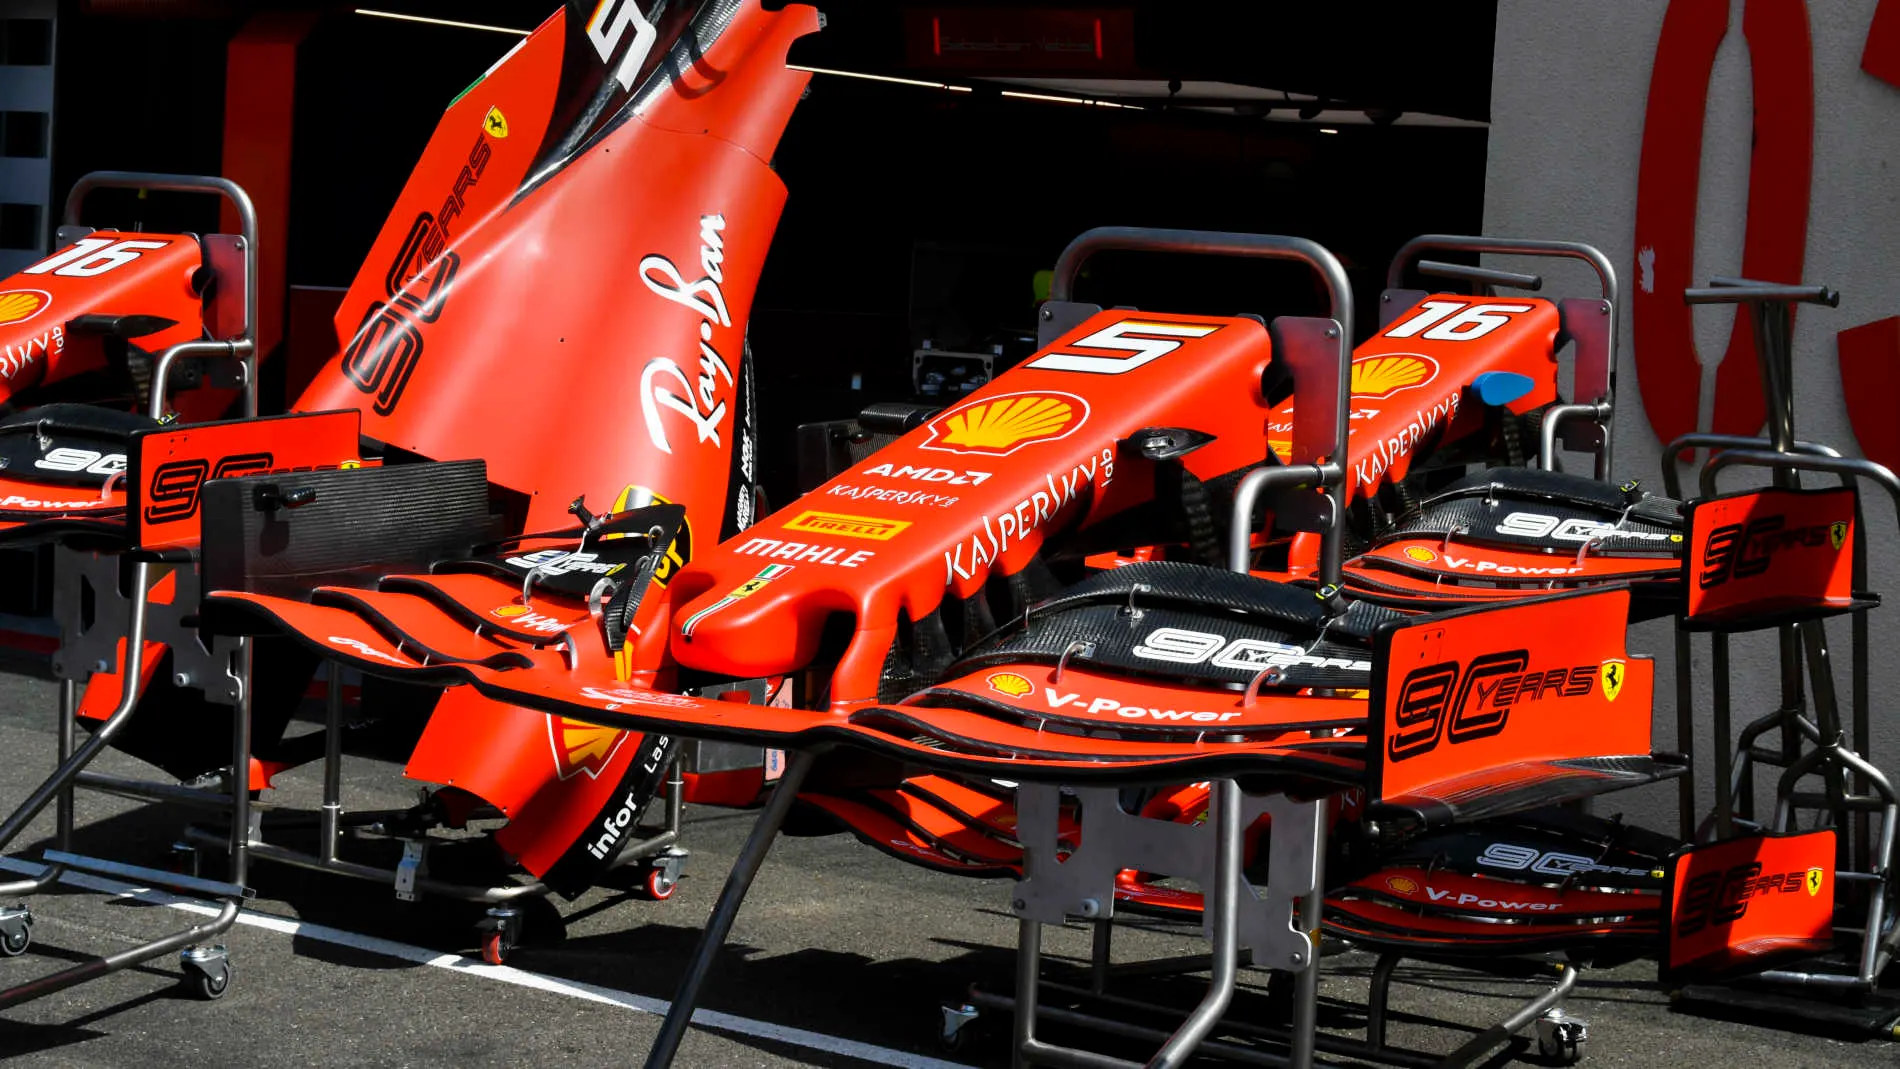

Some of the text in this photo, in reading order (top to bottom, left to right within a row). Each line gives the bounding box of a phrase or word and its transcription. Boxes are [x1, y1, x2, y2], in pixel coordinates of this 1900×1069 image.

[585, 0, 657, 93] 5
[23, 237, 173, 277] 16
[1384, 300, 1536, 342] 16
[1024, 318, 1230, 375] 5
[796, 515, 897, 536] PIRELLI
[944, 456, 1097, 586] KASPERSKY
[733, 538, 876, 568] MAHLE
[1443, 555, 1584, 577] V-Power
[1133, 627, 1306, 672] 90
[1044, 687, 1242, 724] V-Power
[1389, 649, 1600, 763] 90 YEARS
[587, 792, 638, 861] infor
[1425, 886, 1563, 911] V-Power
